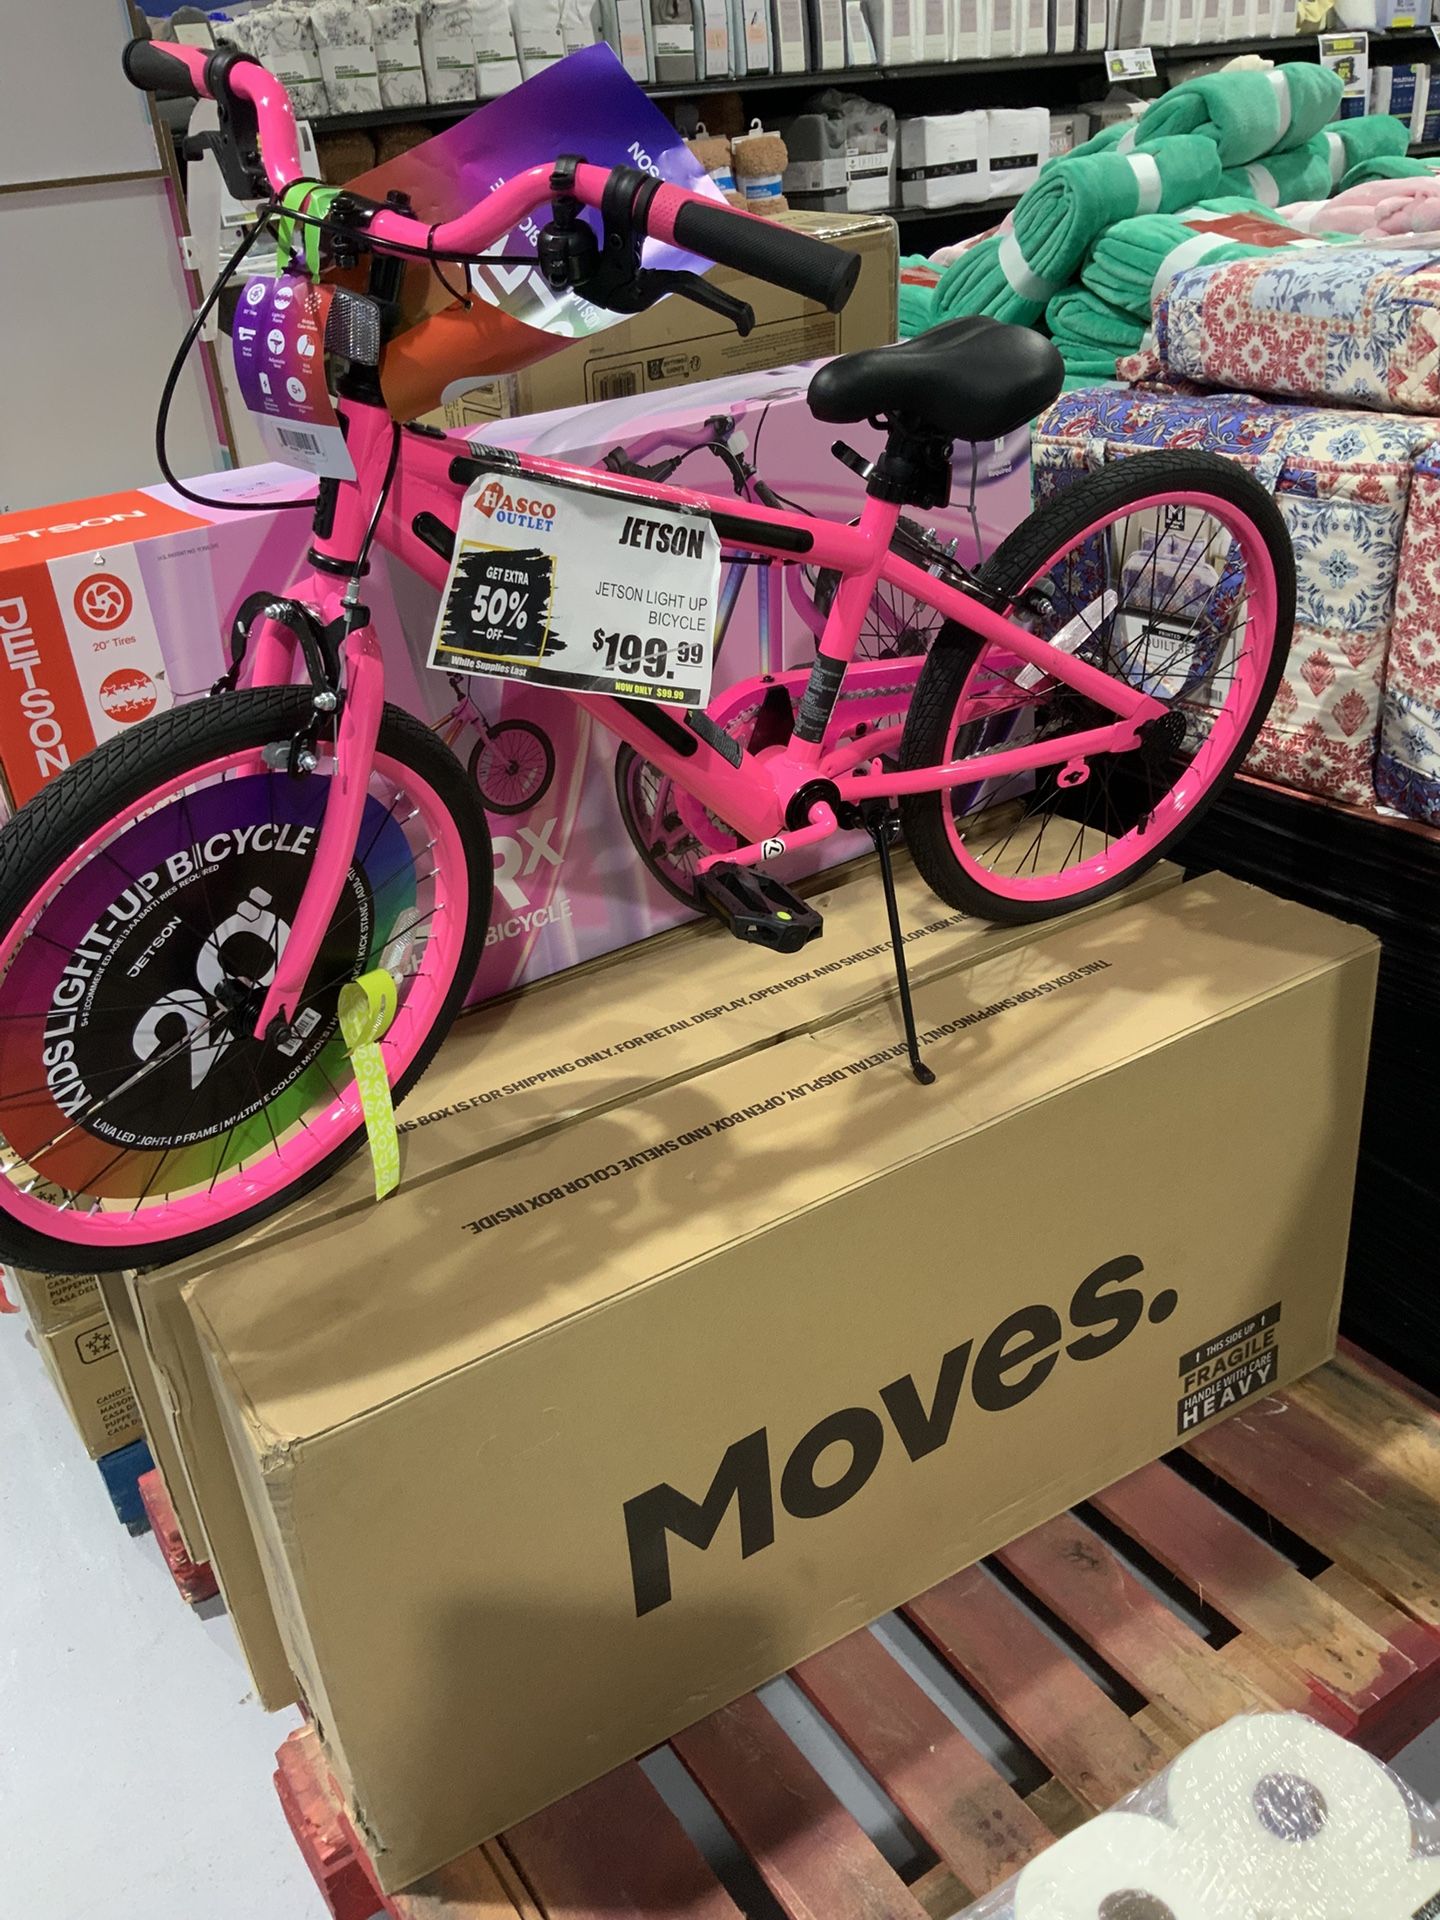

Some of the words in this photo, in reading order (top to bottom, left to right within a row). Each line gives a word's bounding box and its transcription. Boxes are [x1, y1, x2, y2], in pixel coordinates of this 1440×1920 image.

[483, 490, 556, 519] HASCO
[496, 511, 554, 532] OUTLET
[619, 516, 705, 560] JETSON
[486, 566, 503, 582] GET
[504, 570, 529, 586] EXTRA
[471, 585, 529, 630] 50%
[596, 581, 644, 602] JETSON
[646, 589, 685, 609] LIGHT
[688, 597, 708, 611] UP
[486, 628, 503, 641] OFF
[649, 611, 707, 632] BICYCLE
[1158, 630, 1181, 640] PRINTED
[112, 634, 136, 648] Tires
[451, 655, 475, 669] While
[475, 658, 510, 674] Supplies
[510, 664, 527, 677] Last
[0, 596, 71, 778] JETSON
[615, 681, 633, 694] NOW
[634, 682, 652, 696] ONLY
[656, 687, 684, 700] $99.99
[166, 822, 319, 883] BICYCLE
[109, 937, 124, 956] AGE
[130, 918, 140, 930] AA
[484, 899, 573, 946] BICYCLE
[44, 871, 159, 1039] LIGHT-UP
[126, 916, 182, 978] JETSON
[357, 935, 368, 959] KICK
[1054, 969, 1086, 989] BOX
[1085, 959, 1113, 977] THIS
[1012, 987, 1044, 1006] FOR
[1041, 981, 1057, 995] IS
[418, 1107, 453, 1127] BOX
[452, 1100, 470, 1113] IS
[469, 1090, 503, 1107] FOR
[501, 1062, 576, 1095] SHIPPING
[614, 1036, 648, 1053] FOR
[646, 1018, 695, 1042] RETAIL
[748, 981, 788, 1003] OPEN
[786, 971, 814, 988] BOX
[812, 962, 843, 979] AND
[840, 943, 888, 967] SHELVE
[924, 918, 952, 937] BOX
[961, 994, 1018, 1028] SHIPPING
[847, 1049, 894, 1075] RETAIL
[42, 1039, 92, 1118] KIDS
[93, 1118, 117, 1137] LAVA
[116, 1131, 135, 1143] LED
[182, 1125, 218, 1143] FRAME
[270, 1065, 304, 1096] COLOR
[748, 1094, 784, 1119] OPEN
[711, 1107, 752, 1132] BOX
[678, 1124, 714, 1147] AND
[619, 1140, 680, 1172] SHELVE
[566, 1163, 622, 1195] COLOR
[530, 1181, 569, 1210] BOX
[461, 1200, 532, 1235] INSIDE.
[47, 1276, 72, 1289] CASA
[52, 1293, 77, 1306] CASA
[1207, 1340, 1224, 1356] THIS
[1225, 1330, 1242, 1346] SIDE
[1244, 1323, 1255, 1335] UP
[1184, 1328, 1275, 1394] FRAGILE
[1184, 1381, 1222, 1410] HANDLE
[1223, 1365, 1247, 1387] WITH
[1249, 1352, 1272, 1373] CARE
[96, 1387, 127, 1405] CANDY
[1183, 1364, 1271, 1429] HEAVY
[102, 1408, 125, 1422] CASA
[107, 1422, 131, 1437] CASA
[623, 1253, 1179, 1618] Moves.
